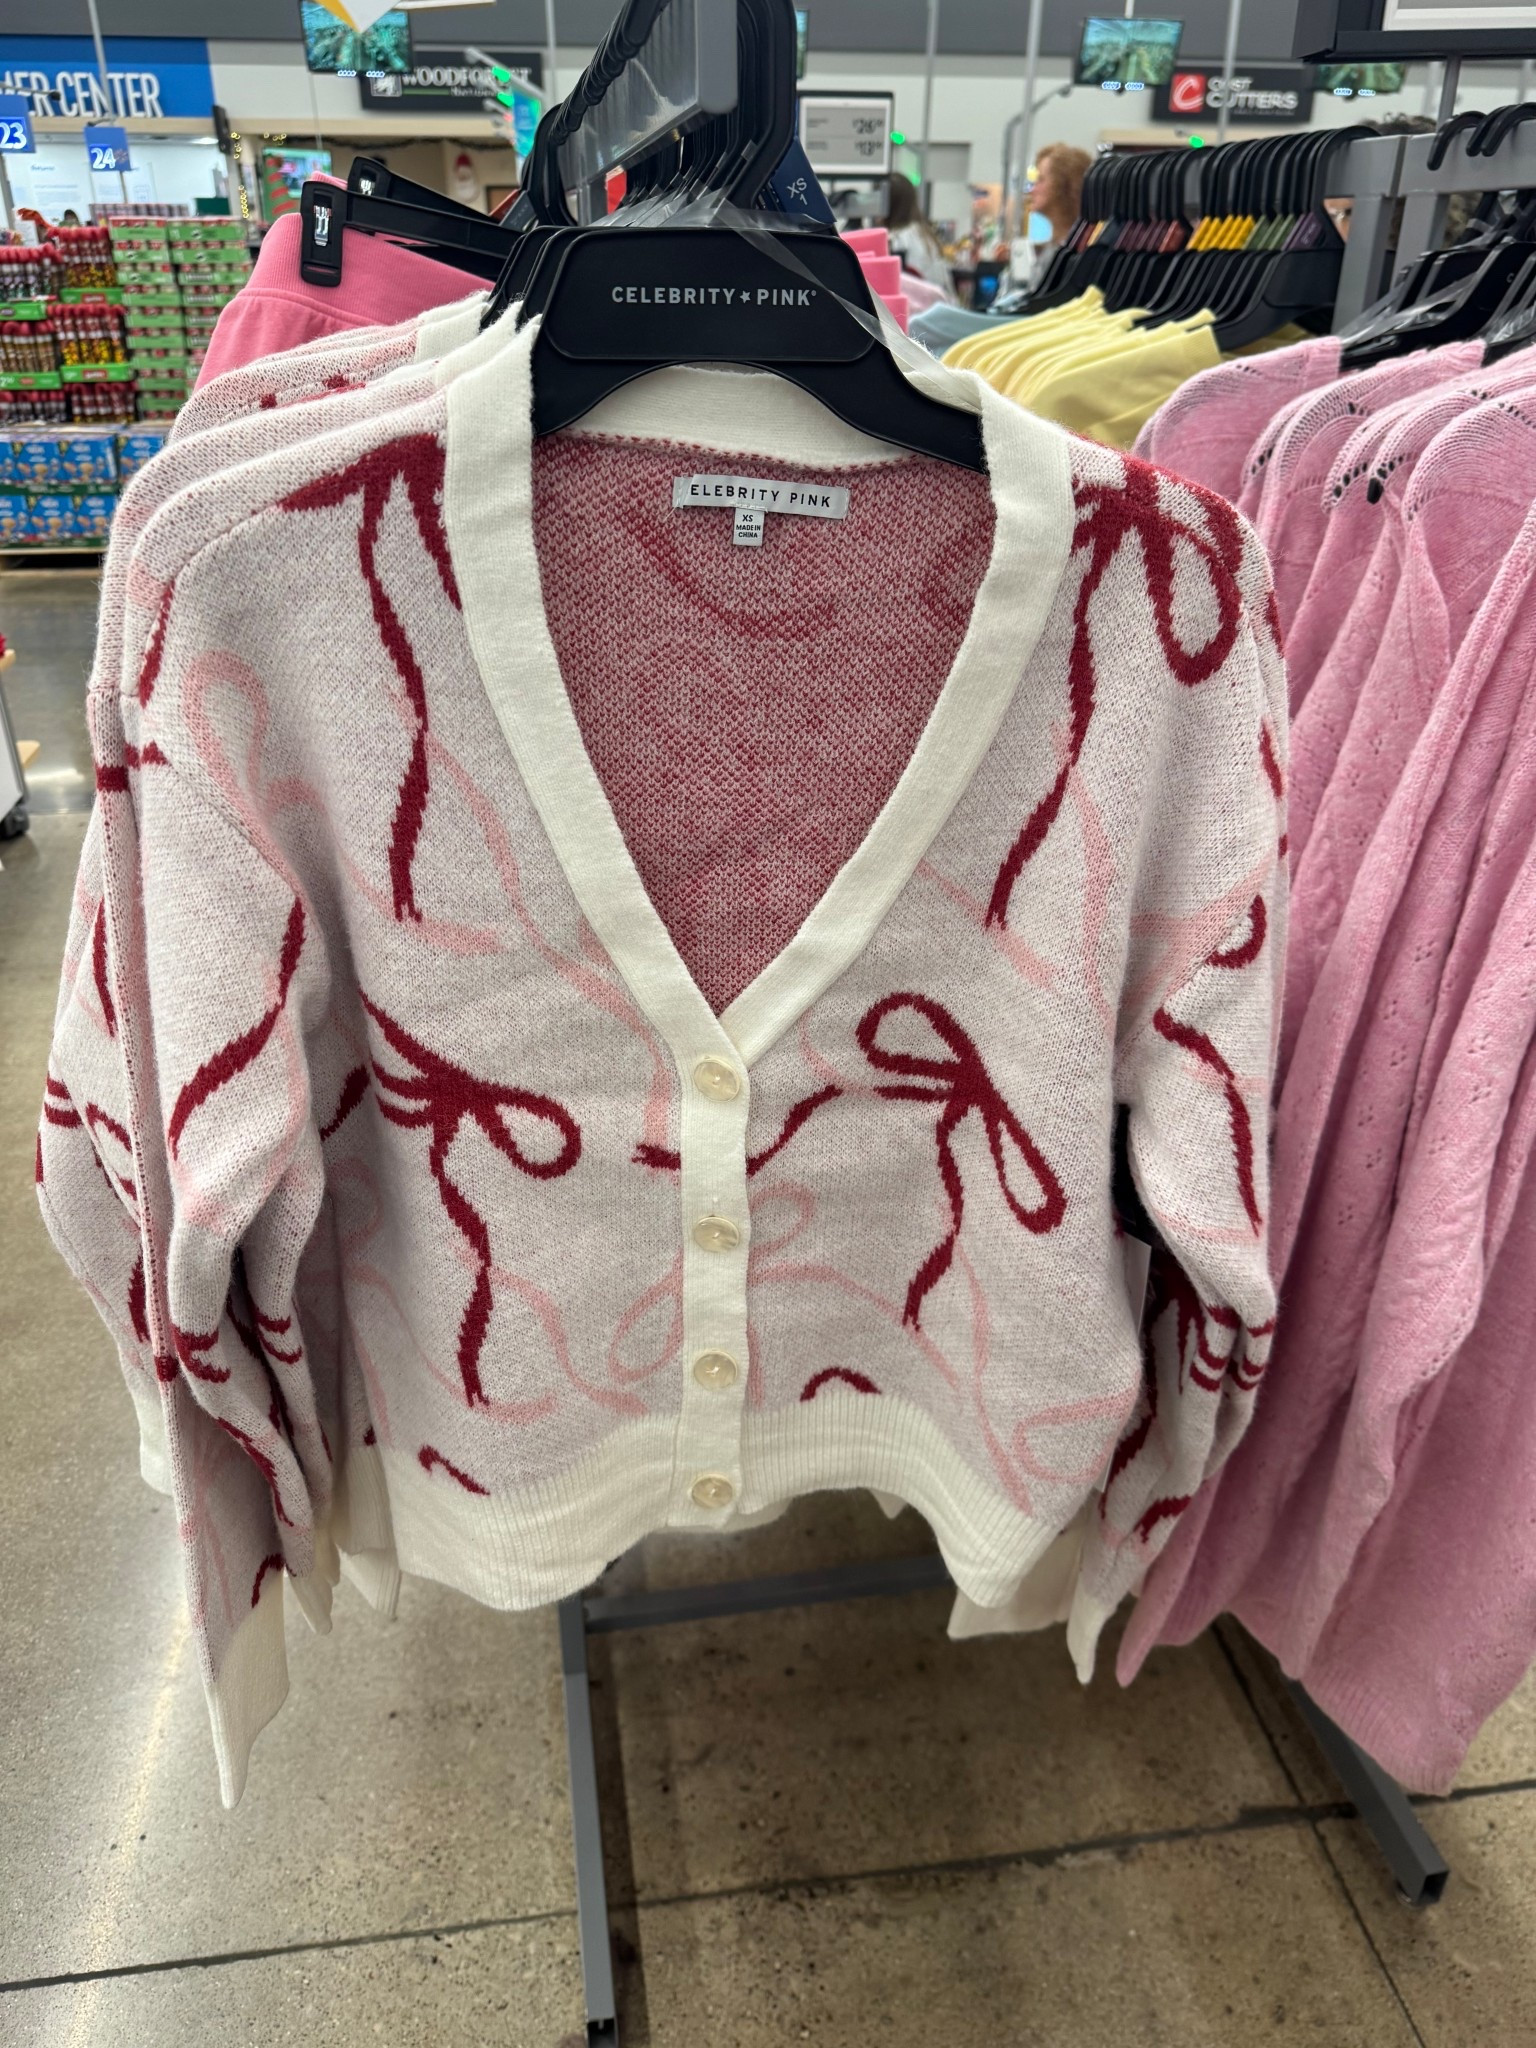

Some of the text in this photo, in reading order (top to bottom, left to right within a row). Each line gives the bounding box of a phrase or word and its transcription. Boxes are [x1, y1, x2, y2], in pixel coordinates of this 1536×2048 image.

[56, 71, 164, 117] CENTER
[0, 122, 27, 150] 23
[91, 147, 116, 169] 24
[787, 177, 808, 199] XS
[799, 193, 808, 206] 1
[611, 286, 736, 304] CELEBRITY
[790, 492, 831, 508] PINK
[742, 514, 754, 523] XS
